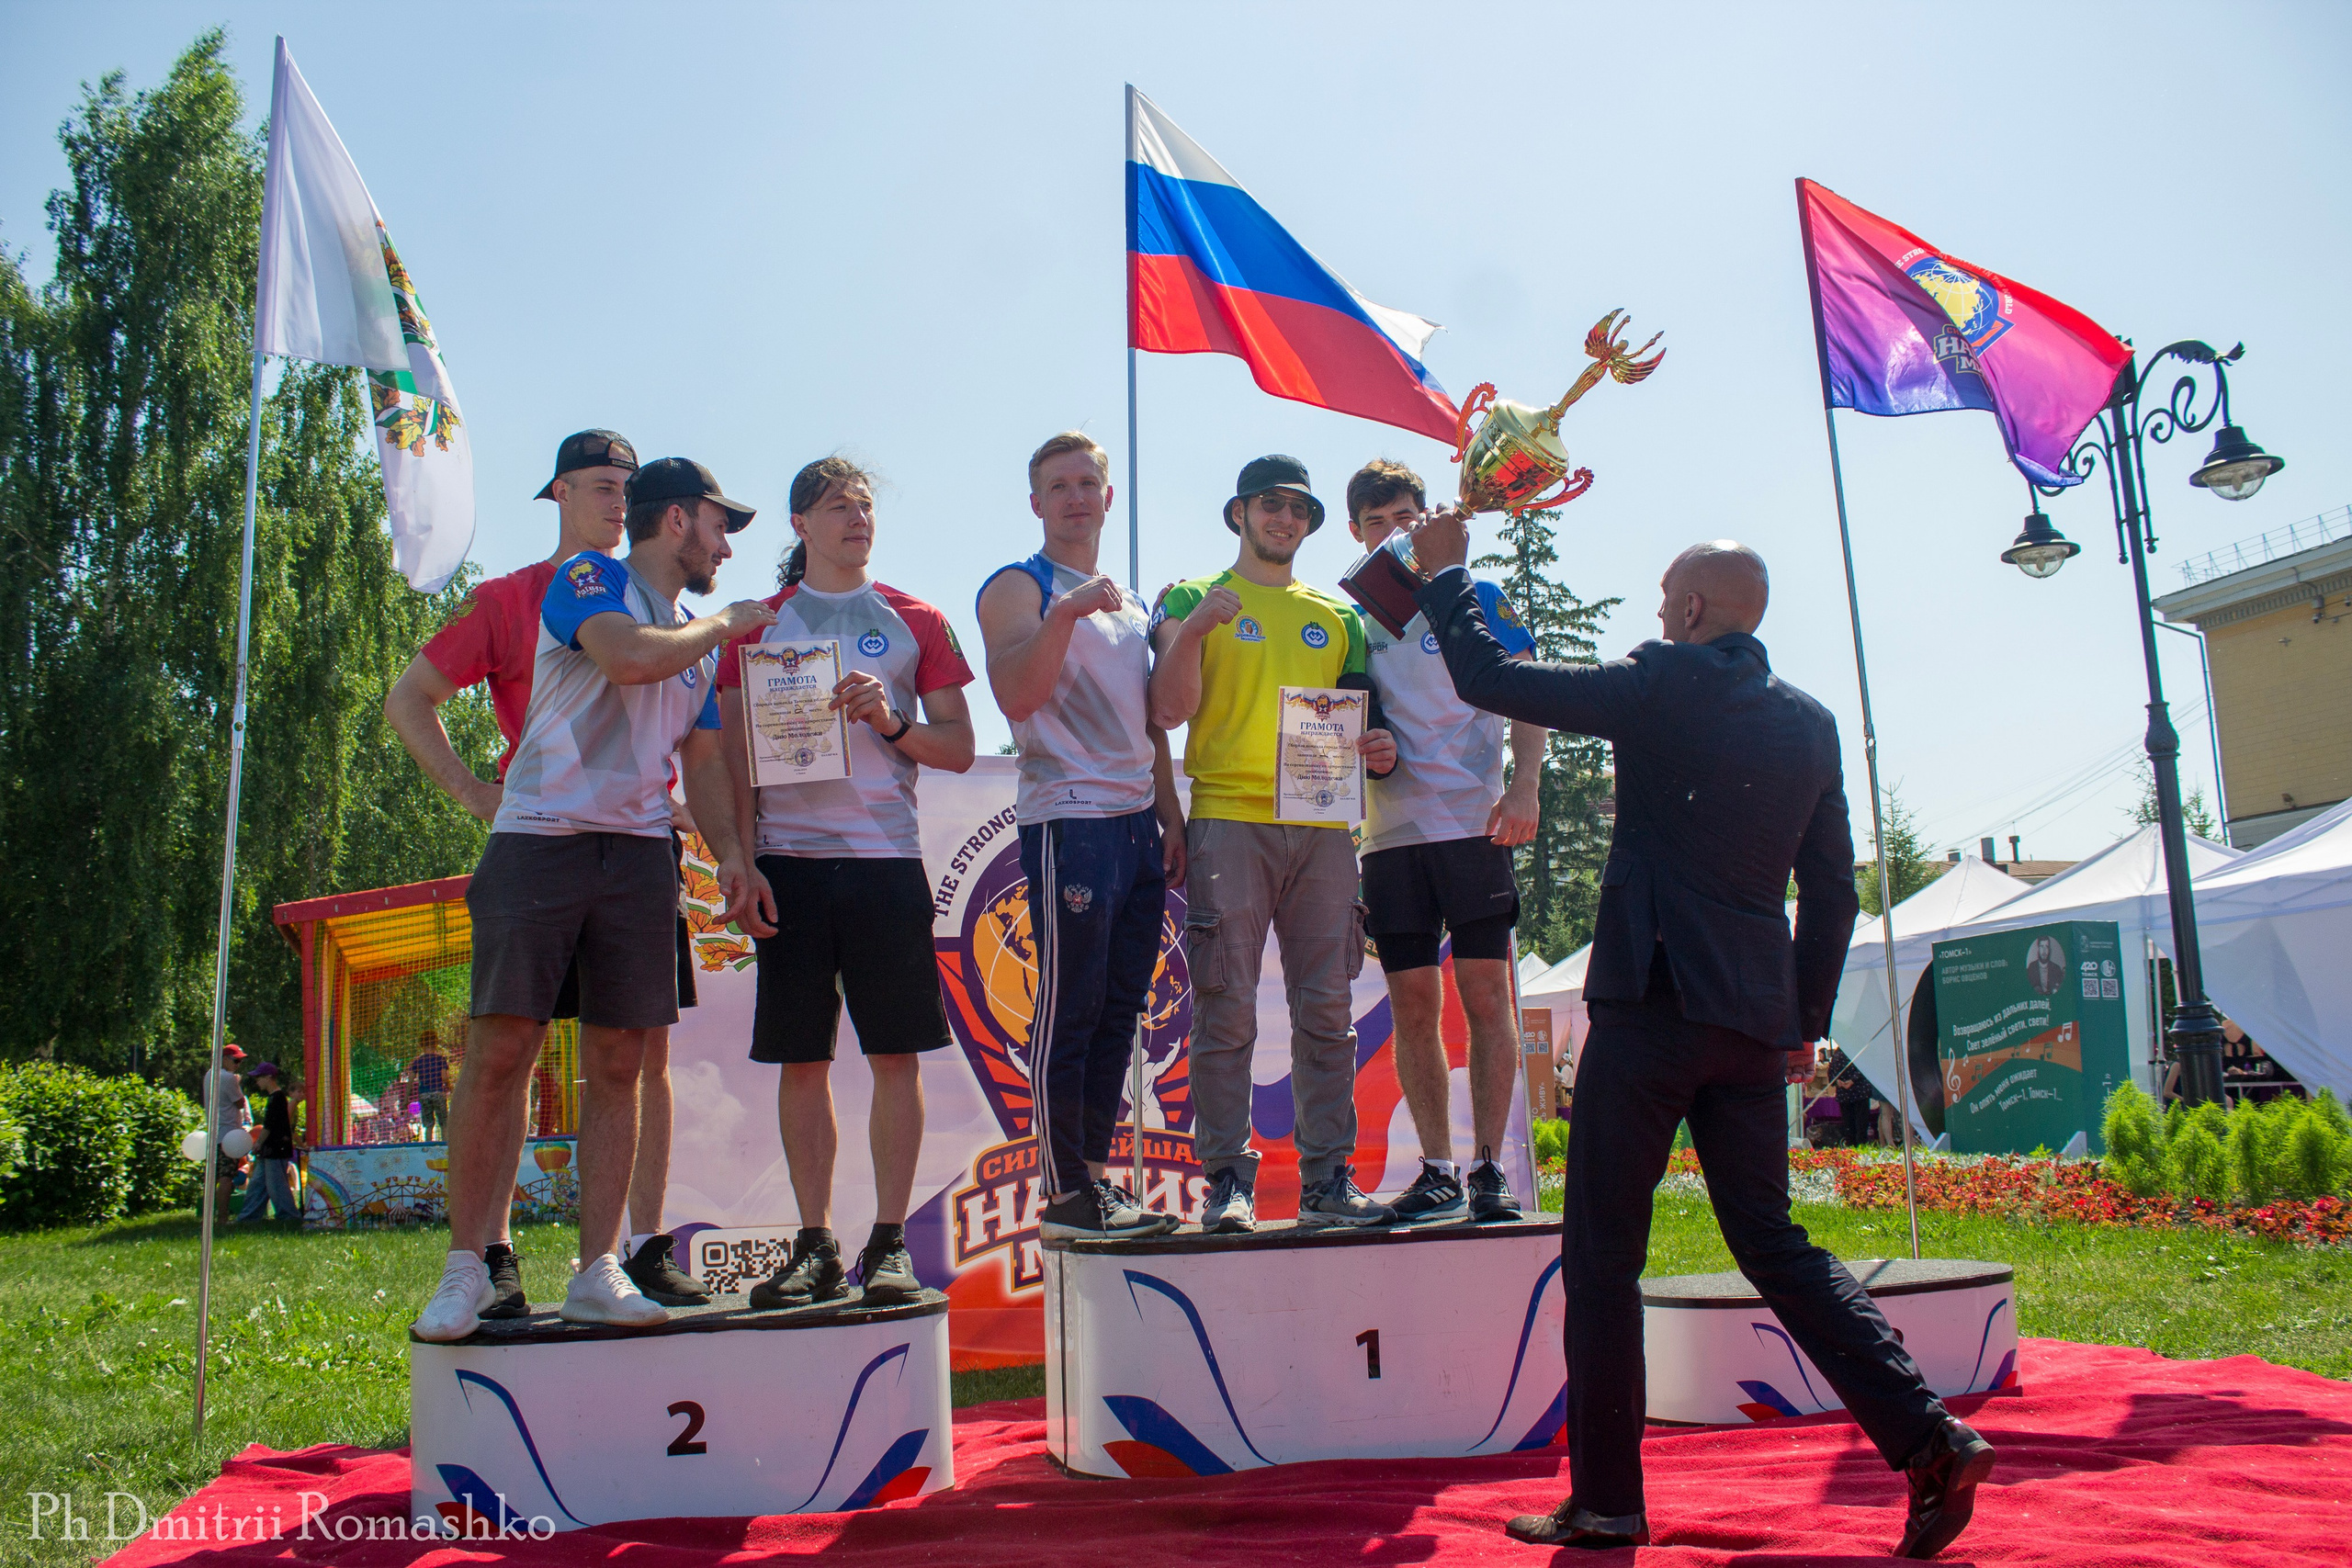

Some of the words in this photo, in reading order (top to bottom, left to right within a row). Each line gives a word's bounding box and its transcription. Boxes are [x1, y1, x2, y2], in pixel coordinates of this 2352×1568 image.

[767, 675, 817, 687] ГРАМОТА
[769, 684, 816, 693] награждается
[1300, 721, 1344, 732] ГРАМОТА
[934, 874, 959, 917] THE
[951, 804, 1017, 875] STRONG
[1941, 965, 1959, 975] АВТОР
[1960, 962, 1984, 972] МУЗЫКИ
[2080, 961, 2098, 972] 420
[1942, 975, 1961, 985] БОРИС
[1952, 1018, 1994, 1037] Возвращаюсь
[1994, 1012, 2002, 1023] из
[2002, 1001, 2029, 1020] дальних
[1966, 1039, 1981, 1052] Свет
[1981, 1027, 2007, 1048] зелёный
[2028, 1014, 2050, 1027] свети!
[1969, 1102, 1979, 1114] Он
[1978, 1093, 1996, 1110] опять
[1994, 1077, 2010, 1097] меня
[2009, 1068, 2037, 1084] ожидает
[1355, 1328, 1382, 1379] 1
[666, 1400, 707, 1457] 2
